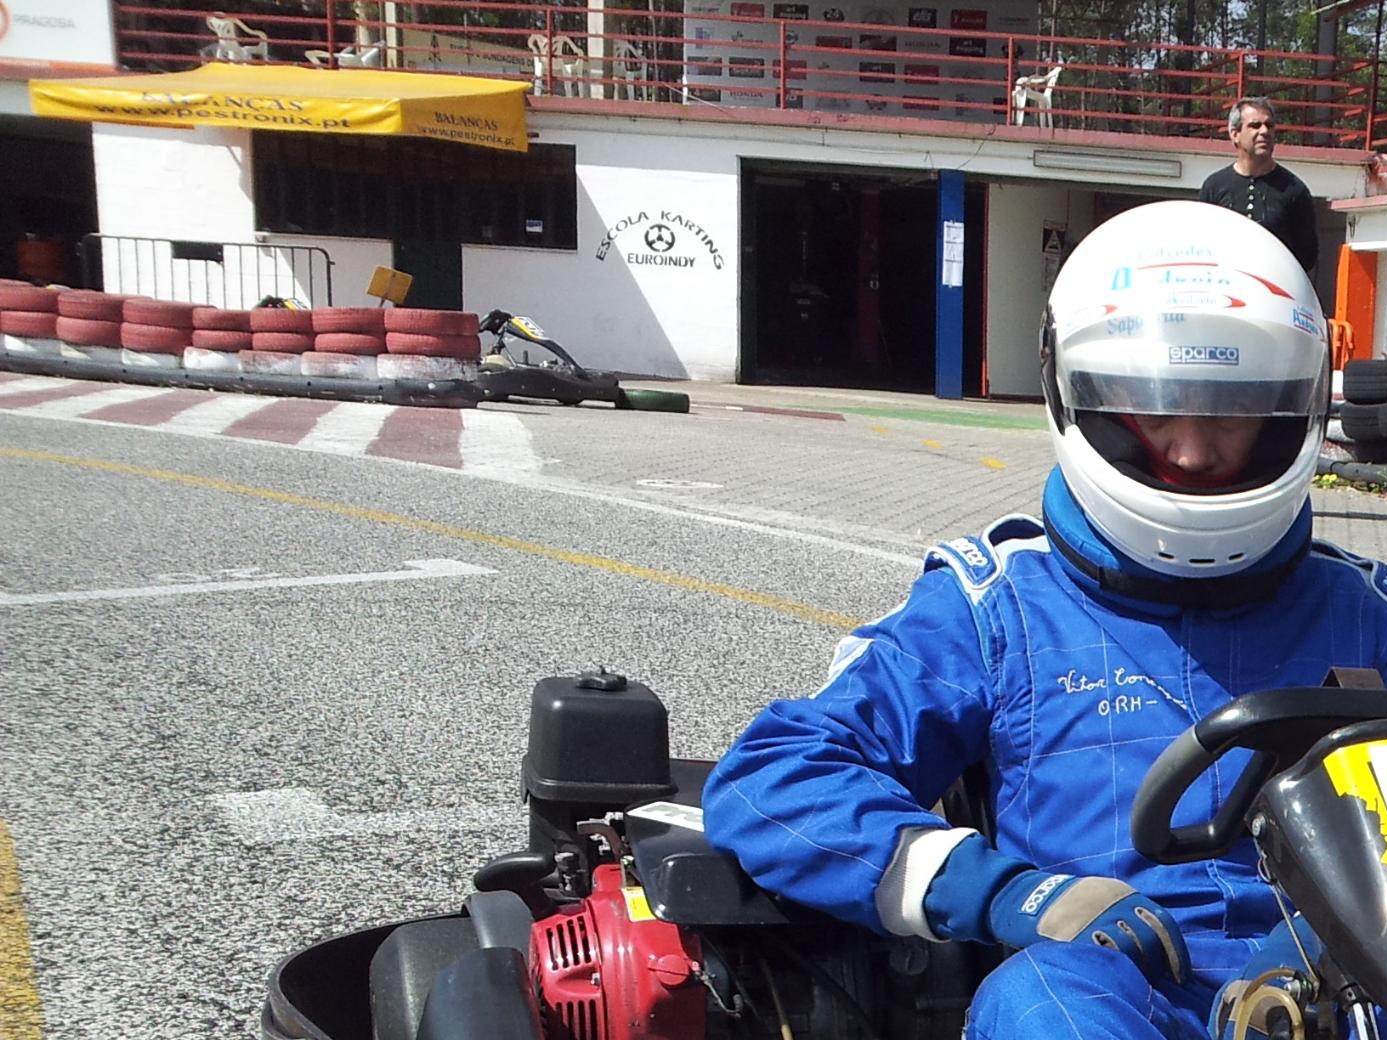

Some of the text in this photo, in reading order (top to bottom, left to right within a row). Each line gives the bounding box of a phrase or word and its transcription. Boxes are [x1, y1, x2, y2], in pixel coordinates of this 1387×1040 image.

[596, 210, 725, 270] ESCOLA KARTING
[628, 253, 695, 267] EUROINDY
[1170, 346, 1238, 363] sparco
